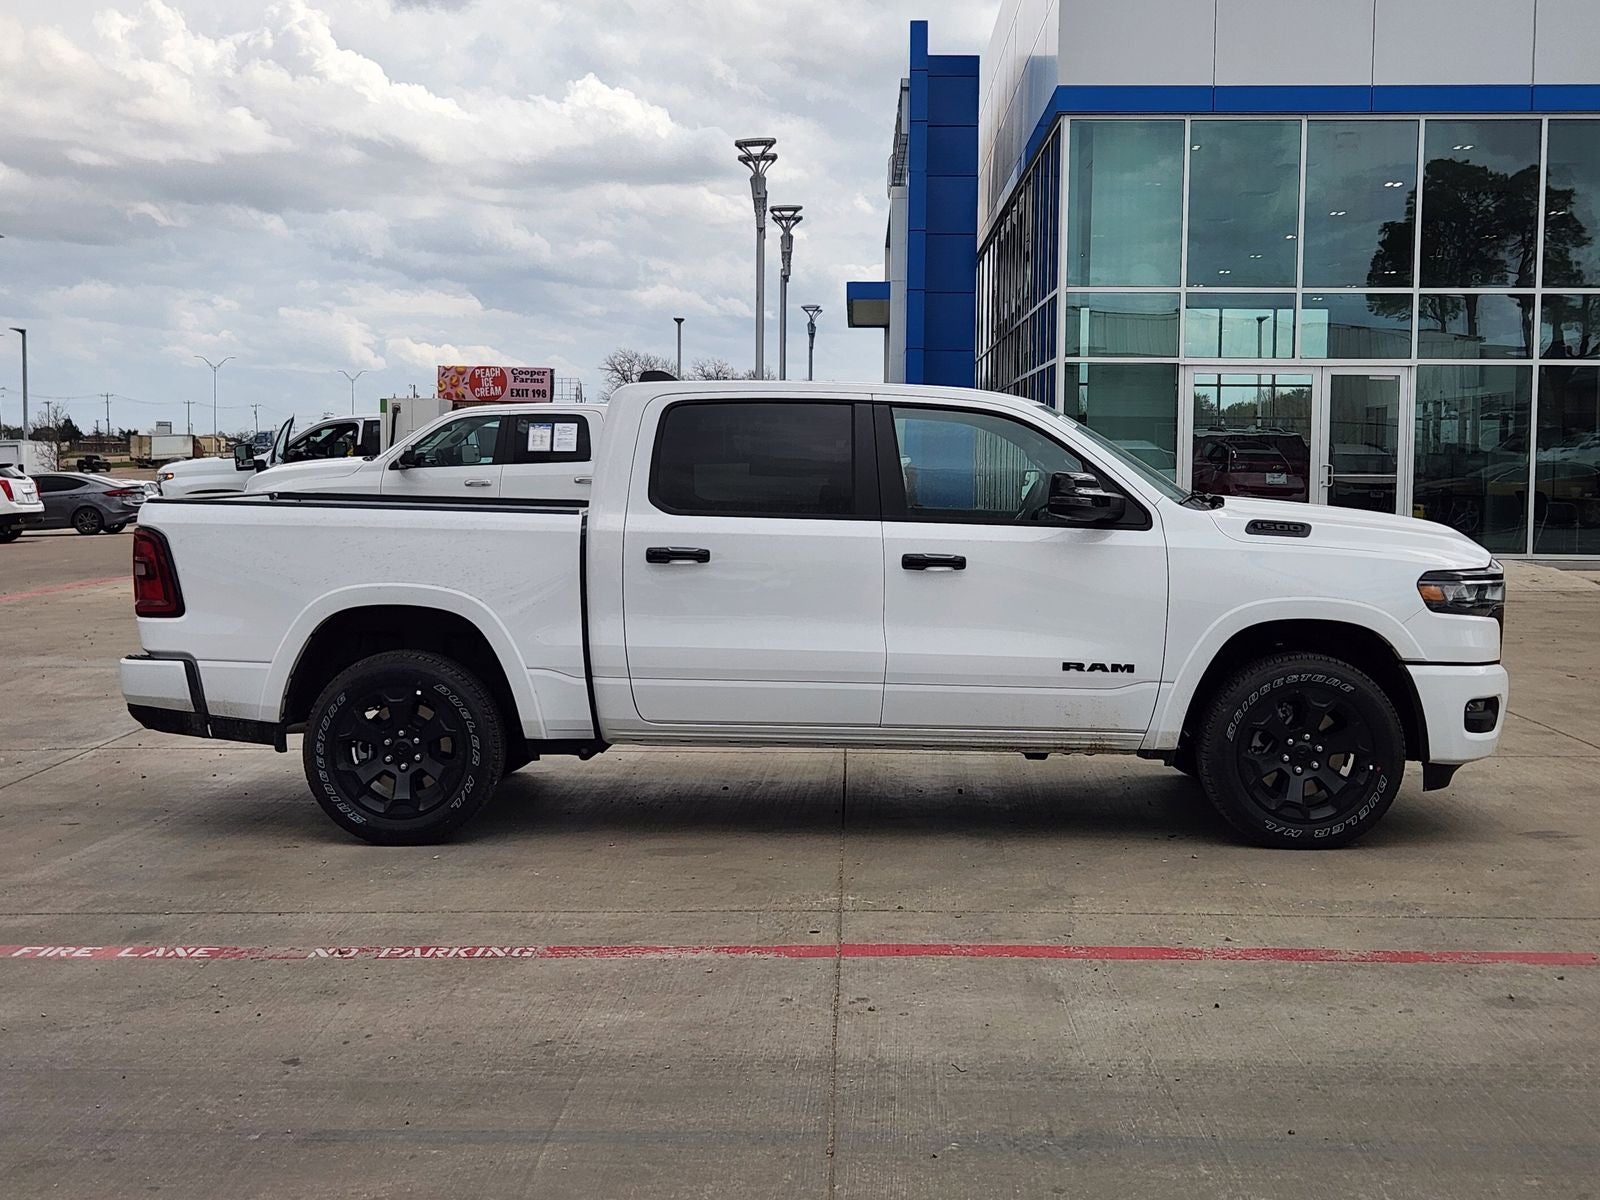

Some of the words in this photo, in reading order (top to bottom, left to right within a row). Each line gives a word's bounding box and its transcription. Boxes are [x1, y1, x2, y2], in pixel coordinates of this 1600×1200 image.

[475, 368, 501, 378] PEACH
[511, 368, 547, 377] Cooper
[481, 378, 494, 387] ICE
[513, 376, 544, 384] Farms
[475, 386, 502, 397] CREAM
[510, 388, 529, 398] EXIT
[532, 389, 547, 398] 198
[1256, 522, 1302, 532] 1500
[1062, 662, 1135, 673] RAM
[1226, 673, 1355, 742] BRIDGESTONE
[433, 683, 480, 767] DUELER
[316, 692, 367, 824] BRIDGESTONE
[1314, 774, 1388, 838] DUELER
[12, 947, 102, 957] FIRE
[117, 947, 219, 957] LANE
[307, 948, 359, 958] NO
[378, 947, 537, 958] PARKING
